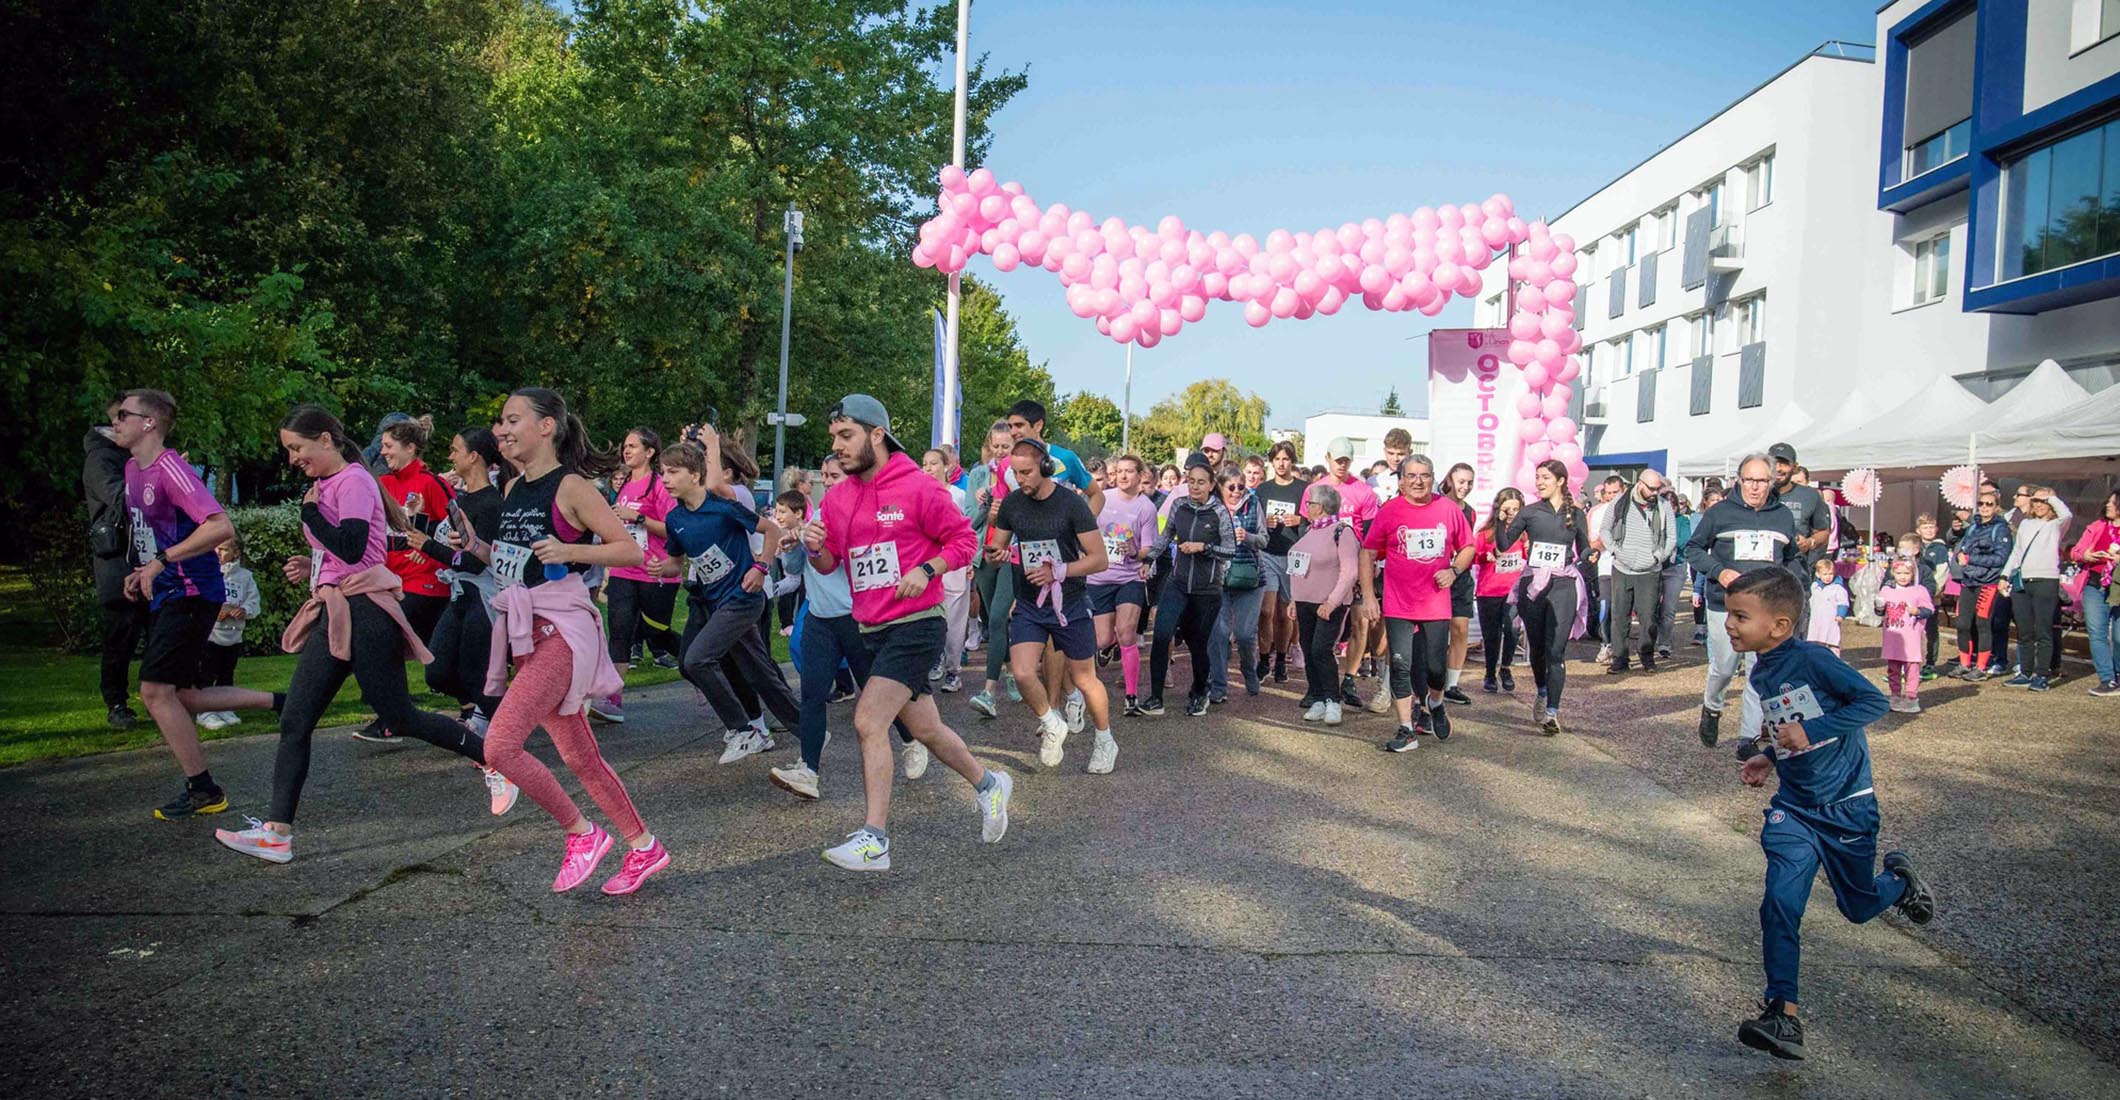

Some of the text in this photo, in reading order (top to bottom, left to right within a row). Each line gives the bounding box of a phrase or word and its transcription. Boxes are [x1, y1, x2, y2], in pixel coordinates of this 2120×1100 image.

[876, 509, 905, 521] Santé
[1418, 538, 1434, 550] 13
[1751, 541, 1759, 551] 7
[1537, 550, 1560, 562] 187
[496, 558, 518, 579] 211
[699, 558, 722, 576] 135
[857, 558, 888, 577] 212
[1294, 559, 1300, 568] 8
[1501, 558, 1518, 567] 281
